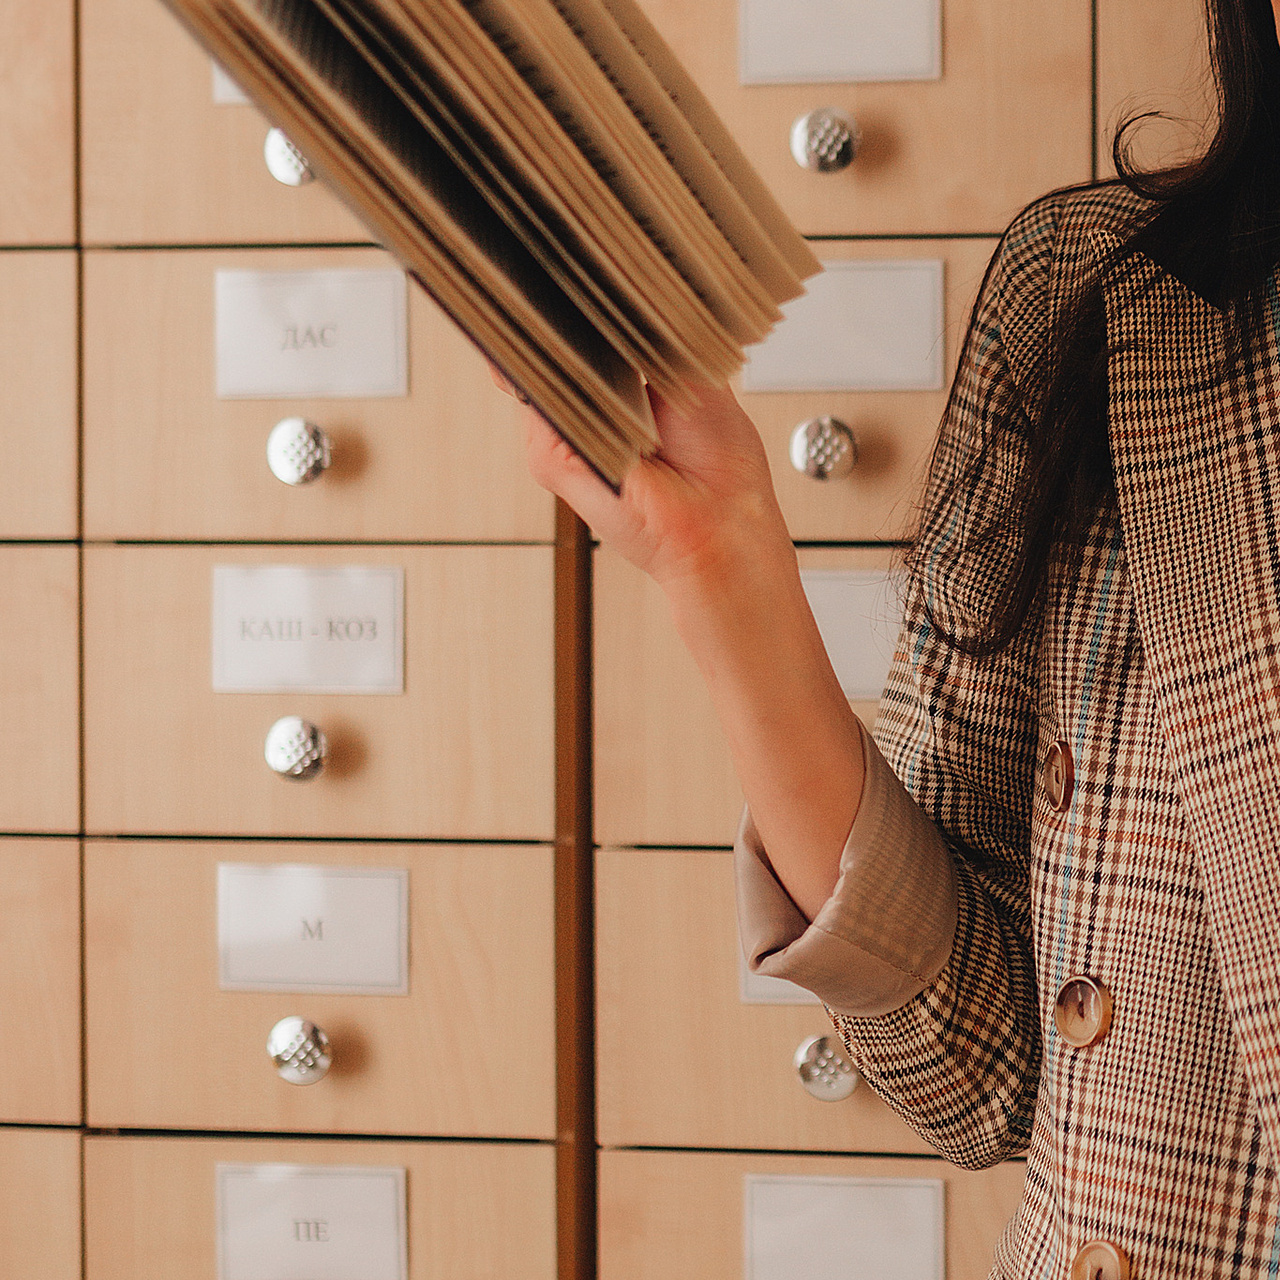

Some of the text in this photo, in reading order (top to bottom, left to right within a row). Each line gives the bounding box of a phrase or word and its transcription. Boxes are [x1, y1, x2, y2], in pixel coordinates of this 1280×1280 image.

[281, 324, 338, 352] ДАС
[239, 618, 304, 642] КАШ
[327, 617, 378, 642] КОЗ
[301, 918, 324, 941] М
[293, 1219, 330, 1242] ПЕ
